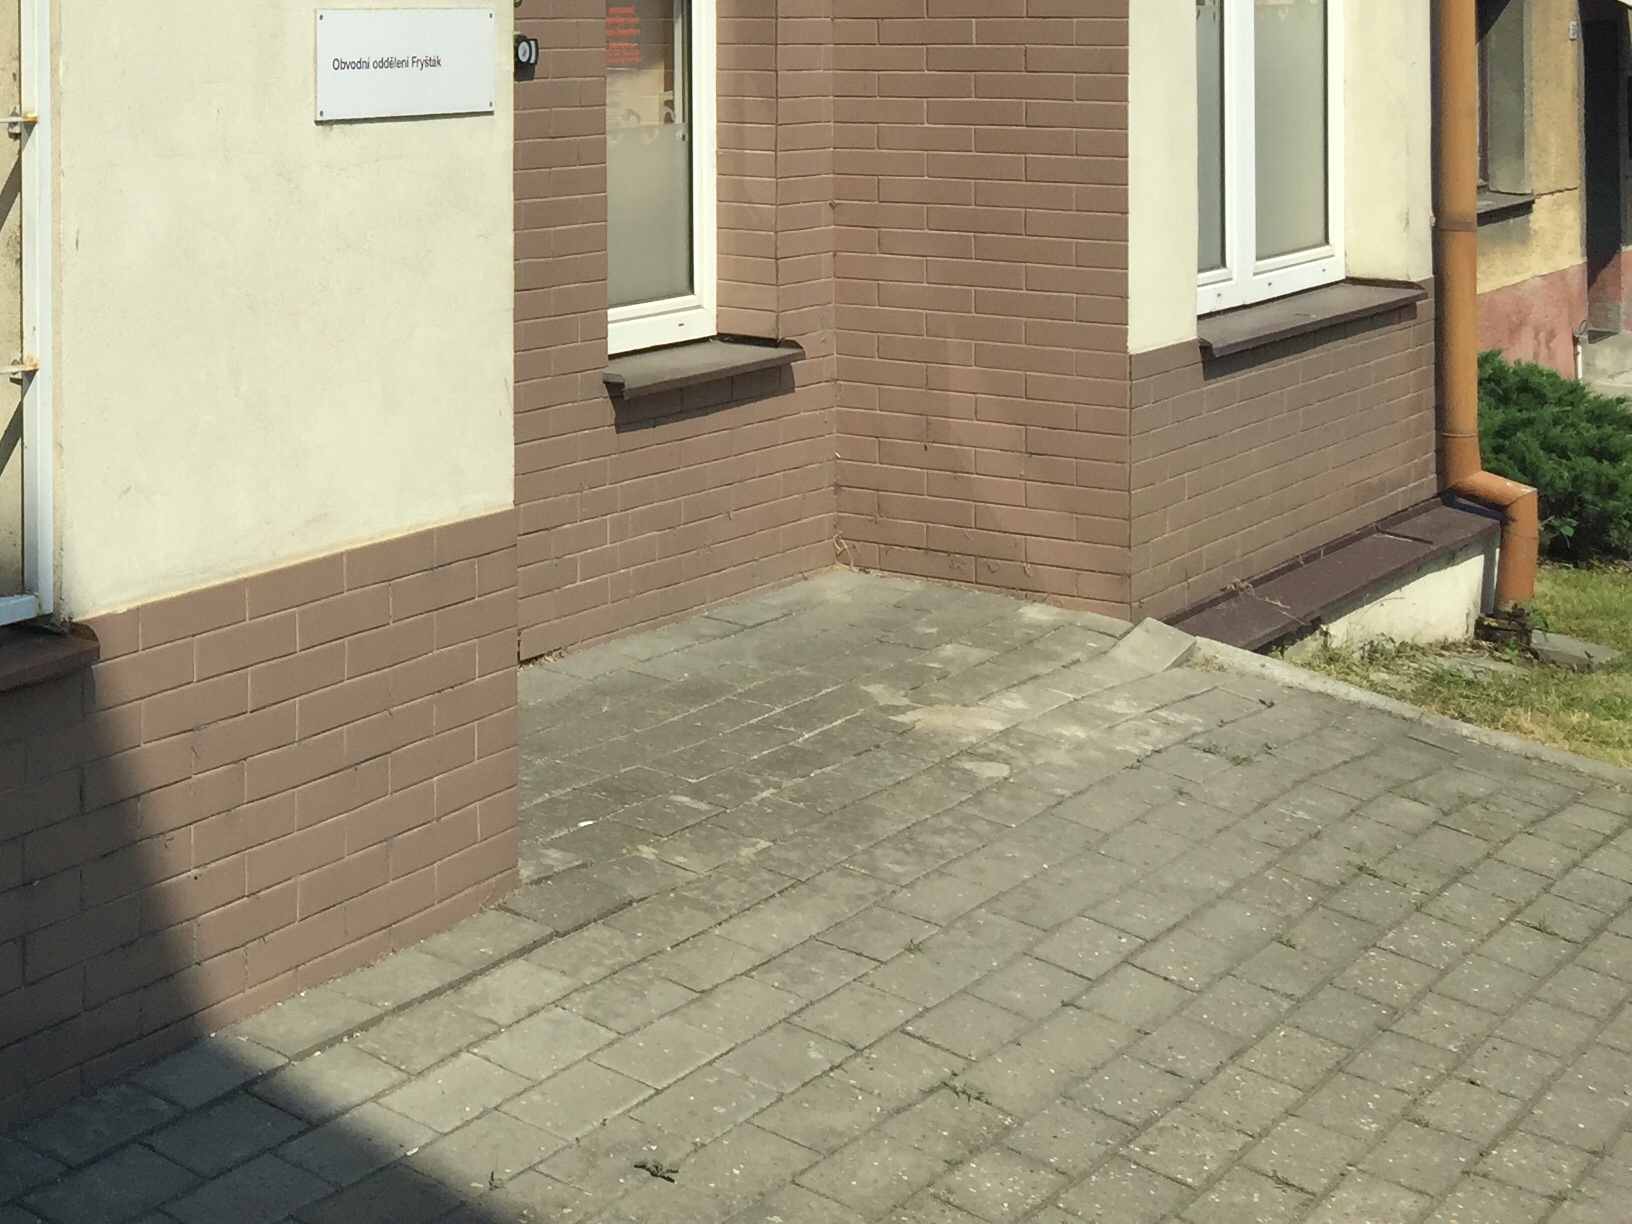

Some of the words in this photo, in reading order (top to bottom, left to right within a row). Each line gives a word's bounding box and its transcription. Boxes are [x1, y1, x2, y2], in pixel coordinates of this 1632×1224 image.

[332, 57, 370, 71] Obvodní
[372, 56, 409, 70] oddělení
[411, 55, 442, 71] Fryšták
